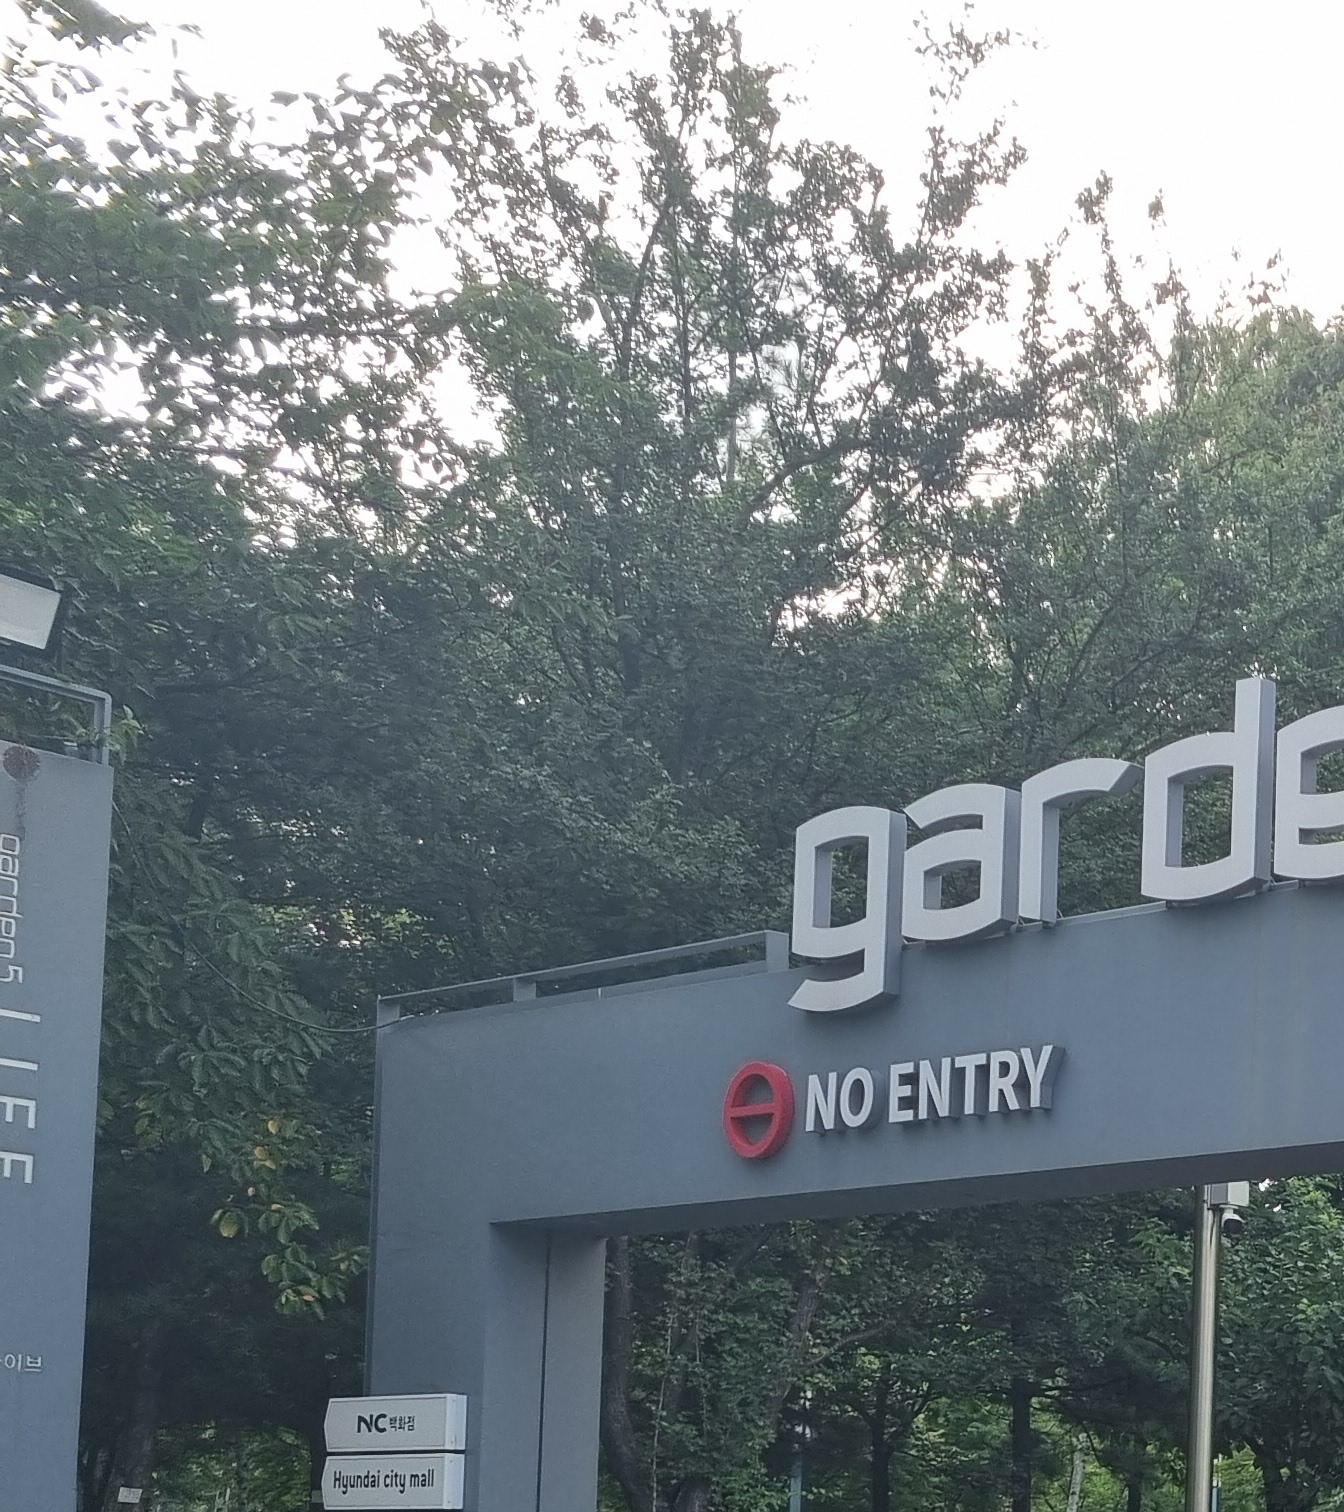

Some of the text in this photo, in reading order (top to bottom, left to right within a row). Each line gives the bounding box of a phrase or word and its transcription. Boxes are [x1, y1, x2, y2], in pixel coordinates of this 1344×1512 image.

[805, 1043, 1064, 1134] NO ENTRY
[0, 1353, 42, 1371] 이브
[357, 1413, 387, 1433] NC
[333, 1469, 435, 1495] Hyundai city mall
